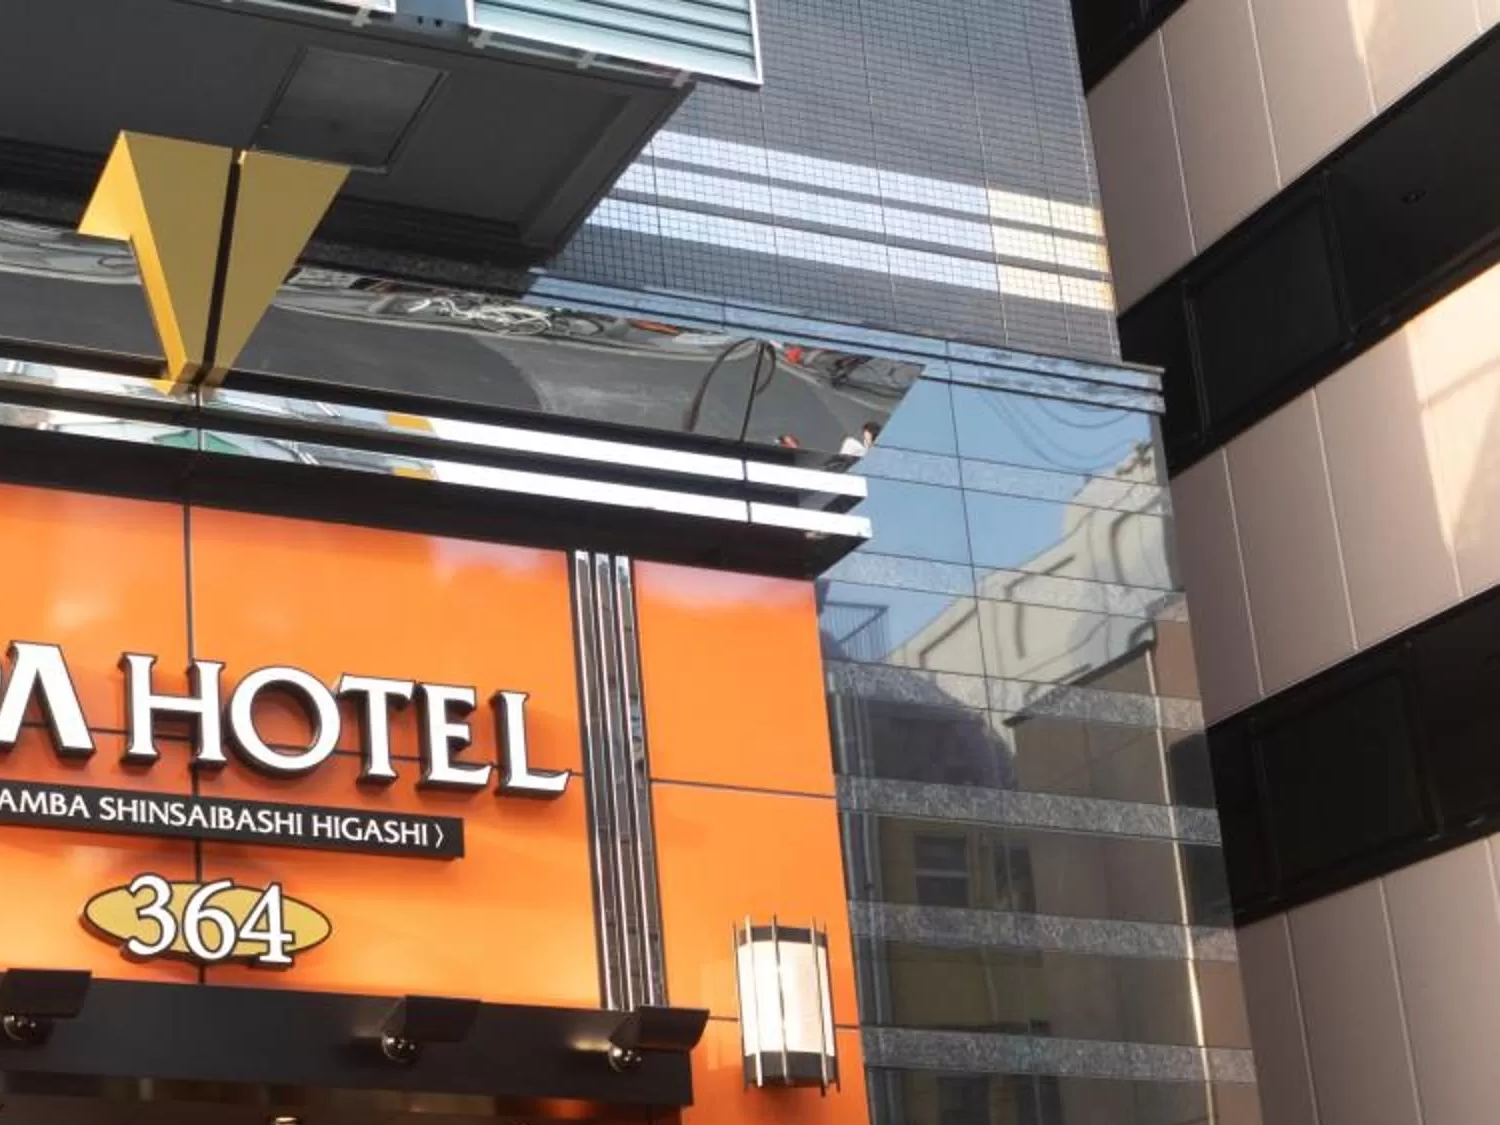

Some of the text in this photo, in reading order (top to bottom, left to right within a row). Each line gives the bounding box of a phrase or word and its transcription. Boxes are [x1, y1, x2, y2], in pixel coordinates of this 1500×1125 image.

[124, 653, 572, 794] HOTEL
[98, 796, 303, 836] SHINSAIBASHI
[127, 873, 294, 965] 364
